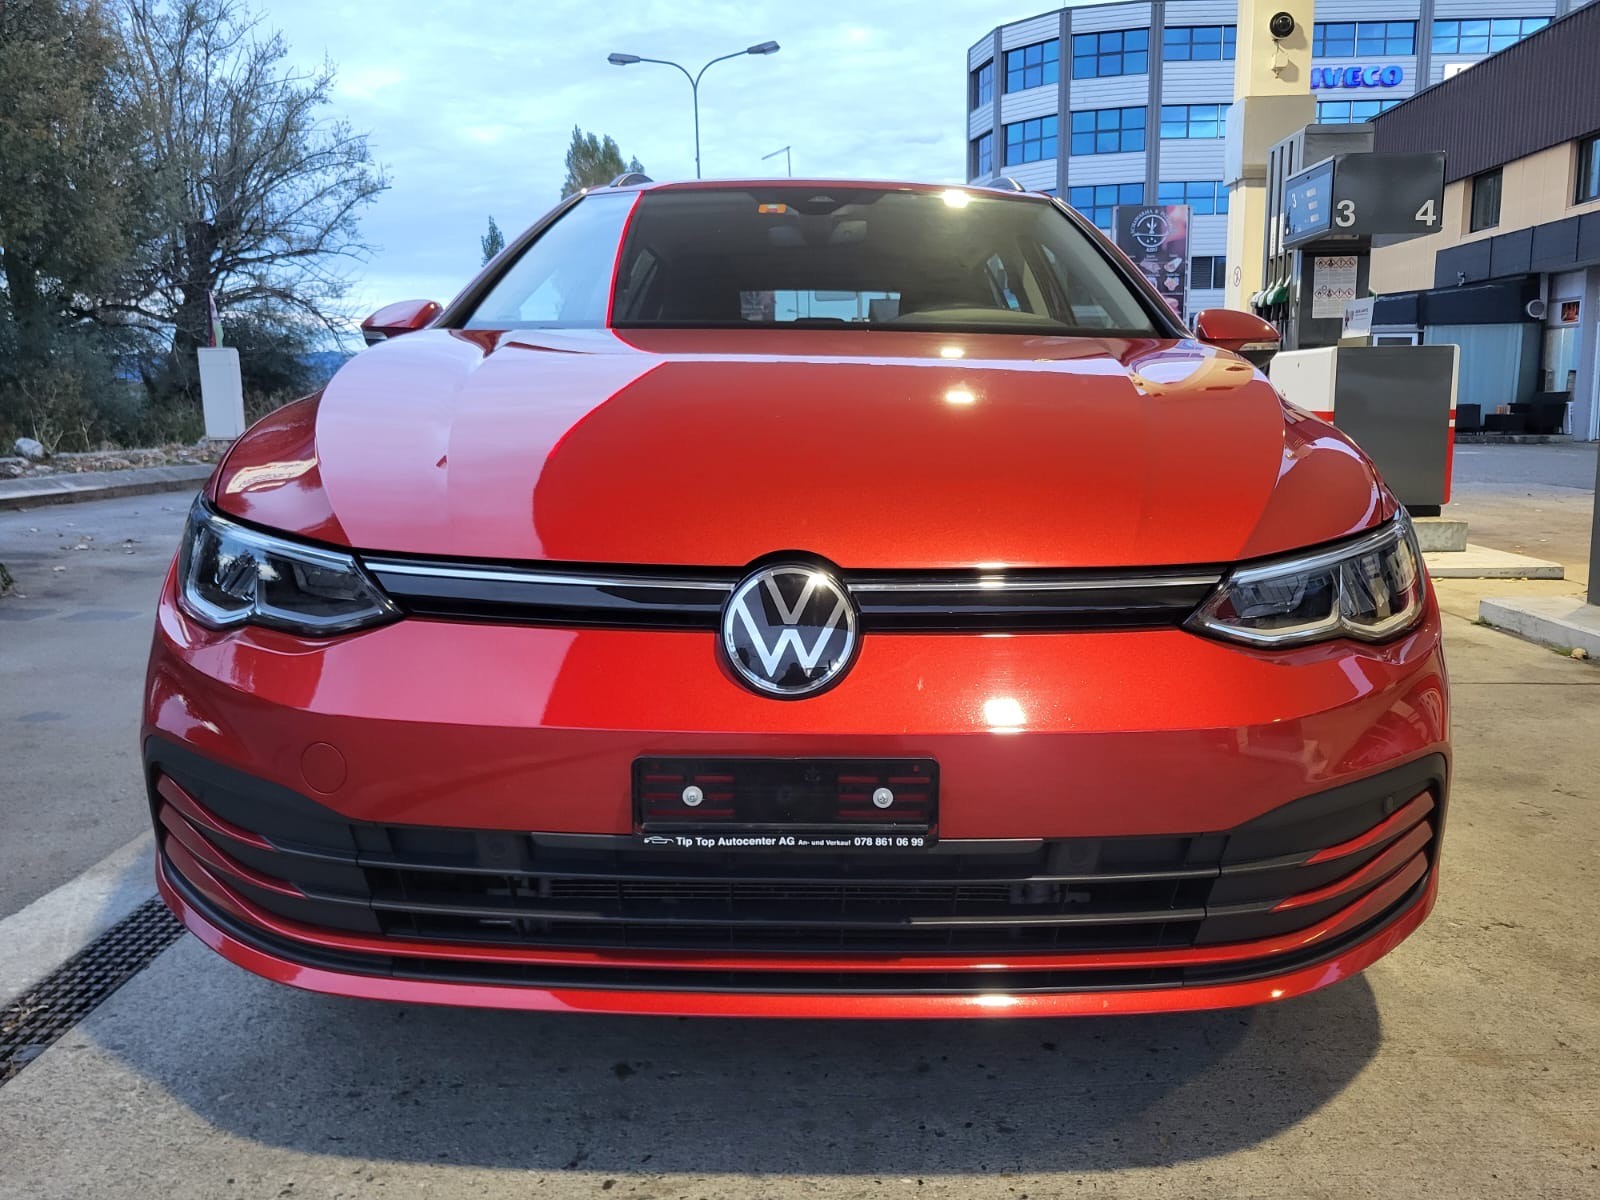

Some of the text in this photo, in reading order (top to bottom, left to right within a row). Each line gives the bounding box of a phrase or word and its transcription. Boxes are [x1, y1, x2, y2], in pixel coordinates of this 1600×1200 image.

[1311, 65, 1404, 89] IVECO
[1291, 193, 1297, 208] 3
[1335, 200, 1356, 227] 3
[1415, 199, 1437, 226] 4
[731, 569, 852, 678] VW
[676, 836, 693, 847] Tip
[695, 837, 715, 848] Top
[718, 836, 776, 846] Autocenter
[779, 836, 795, 846] AG
[854, 837, 873, 846] 078
[875, 837, 893, 846] 861
[896, 837, 909, 846] 06
[911, 837, 924, 847] 99
